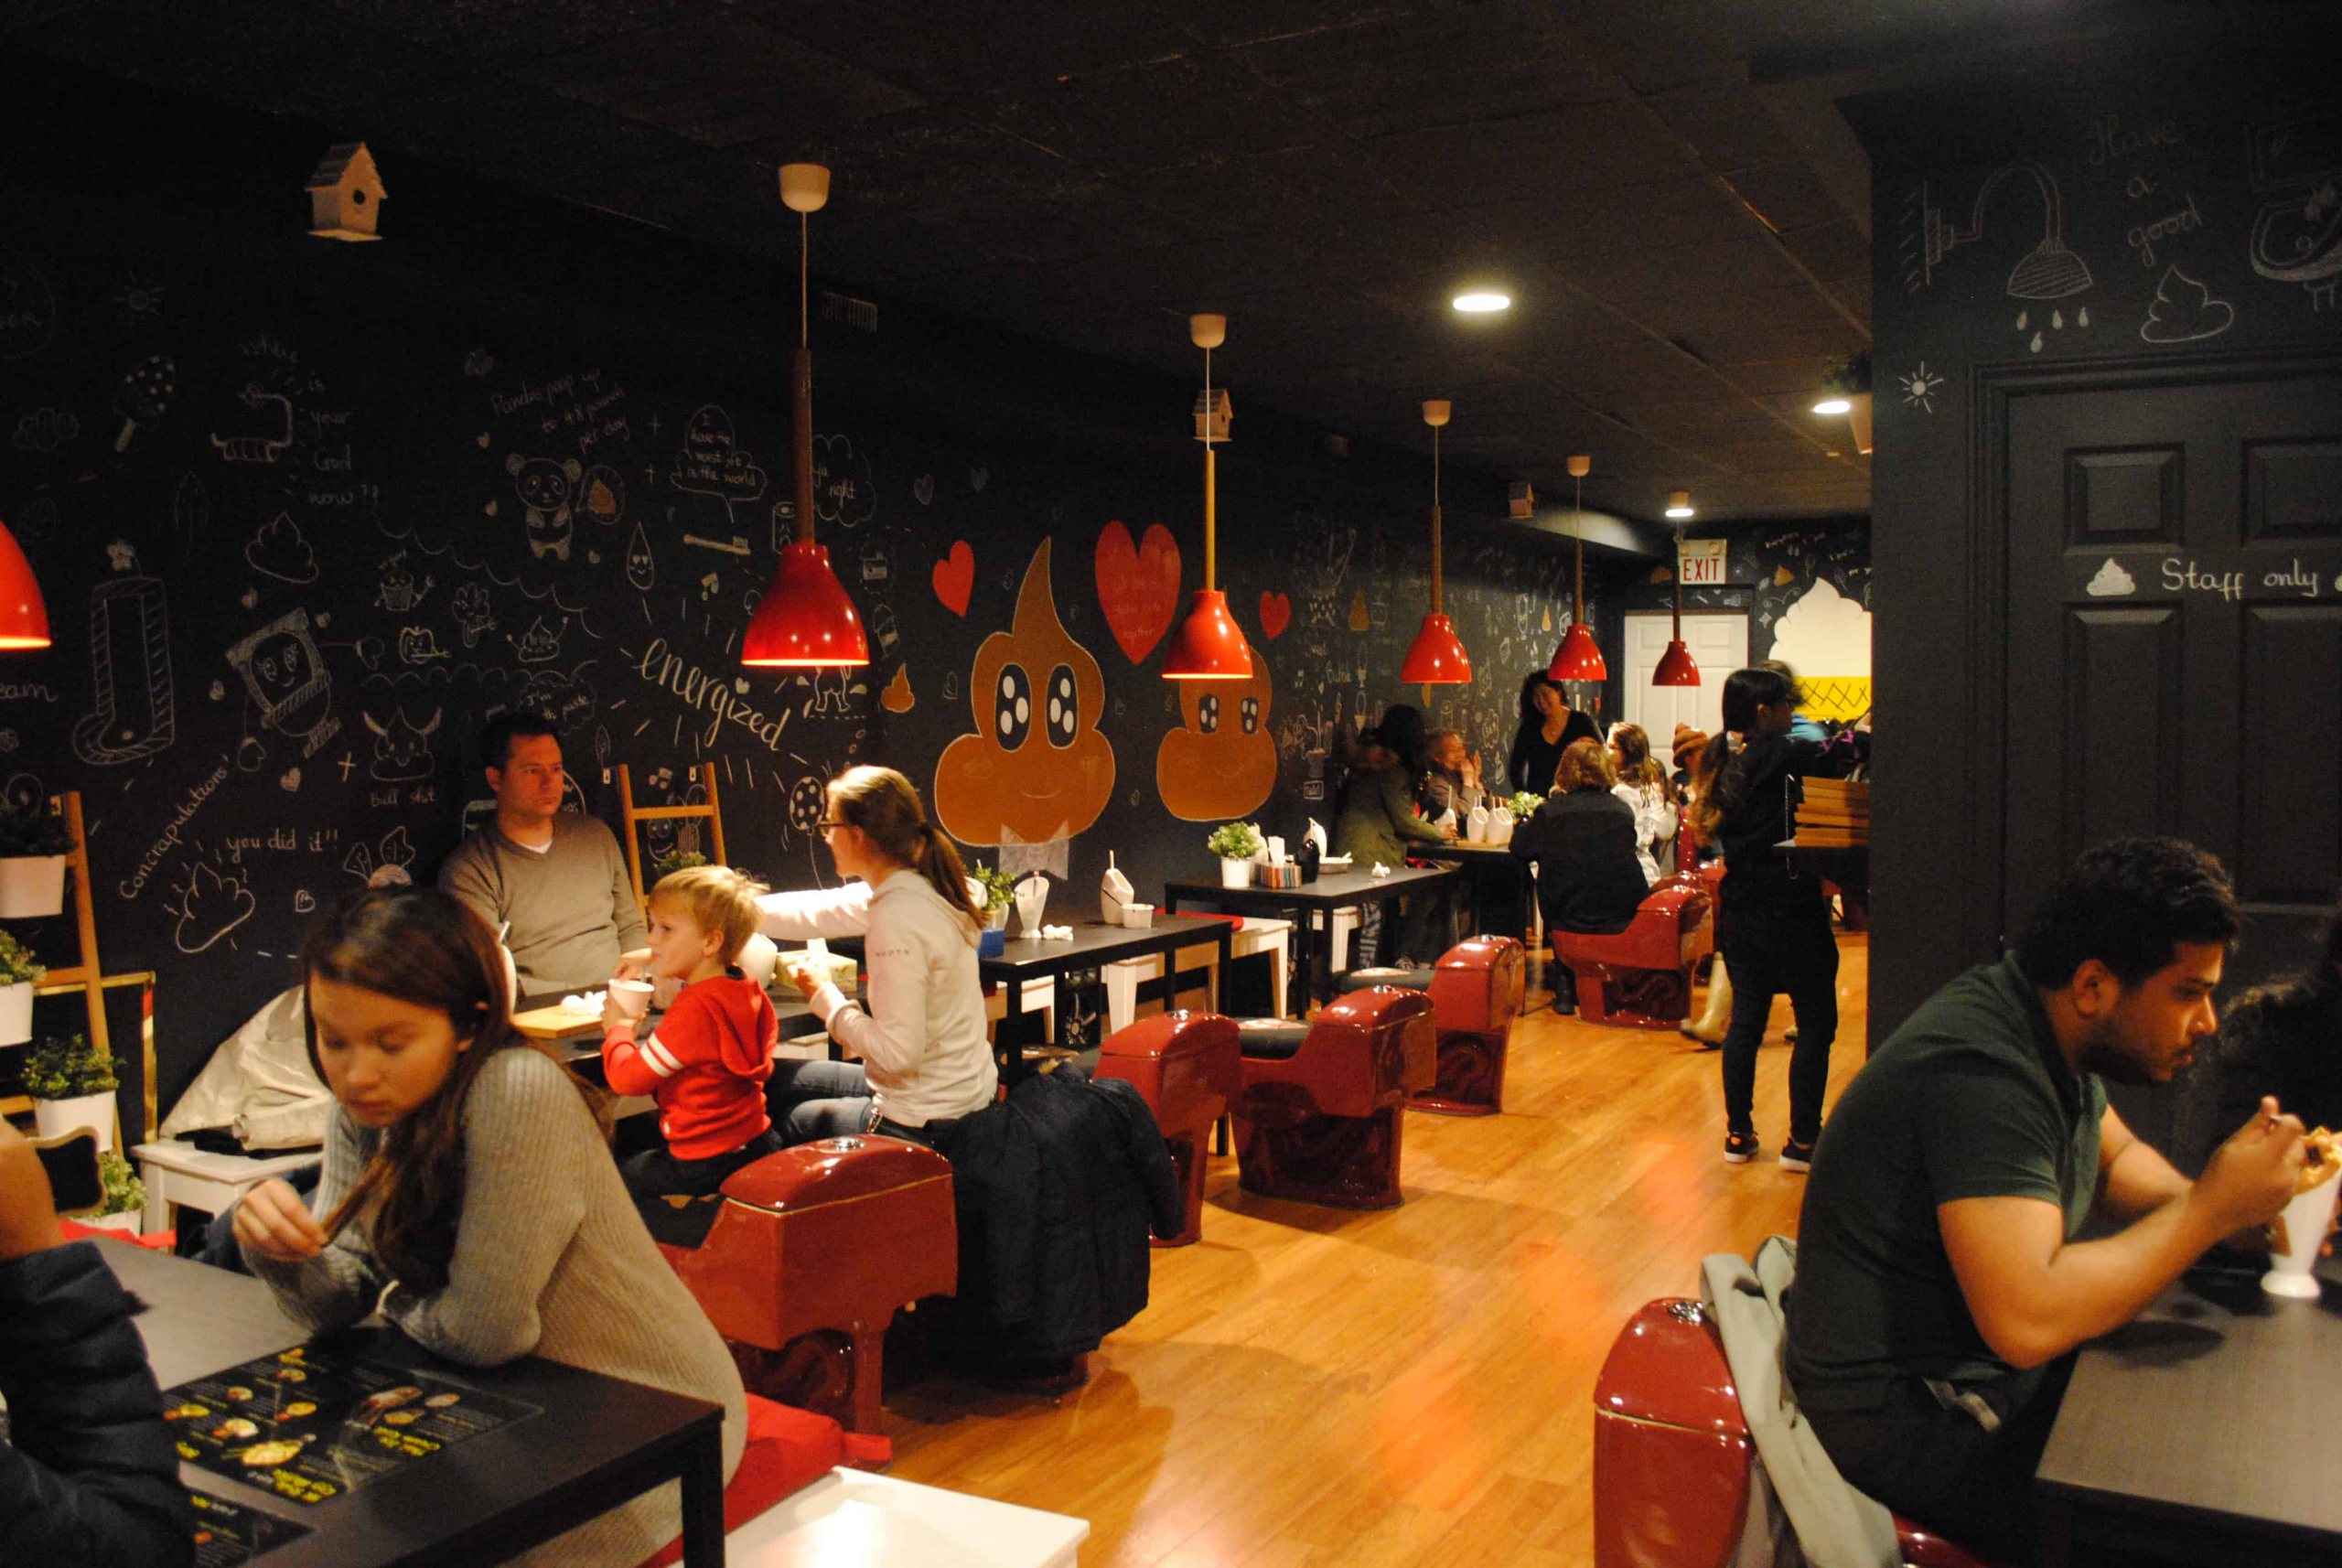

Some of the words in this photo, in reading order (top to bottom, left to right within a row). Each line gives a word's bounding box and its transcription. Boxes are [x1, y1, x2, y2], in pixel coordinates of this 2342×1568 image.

[2126, 176, 2159, 199] a
[2127, 191, 2203, 268] good
[605, 415, 631, 442] day
[1683, 559, 1720, 581] EXIT
[2162, 558, 2244, 602] Staff
[2263, 558, 2318, 597] only
[631, 637, 792, 752] energized
[225, 834, 261, 865] you
[268, 827, 297, 851] did
